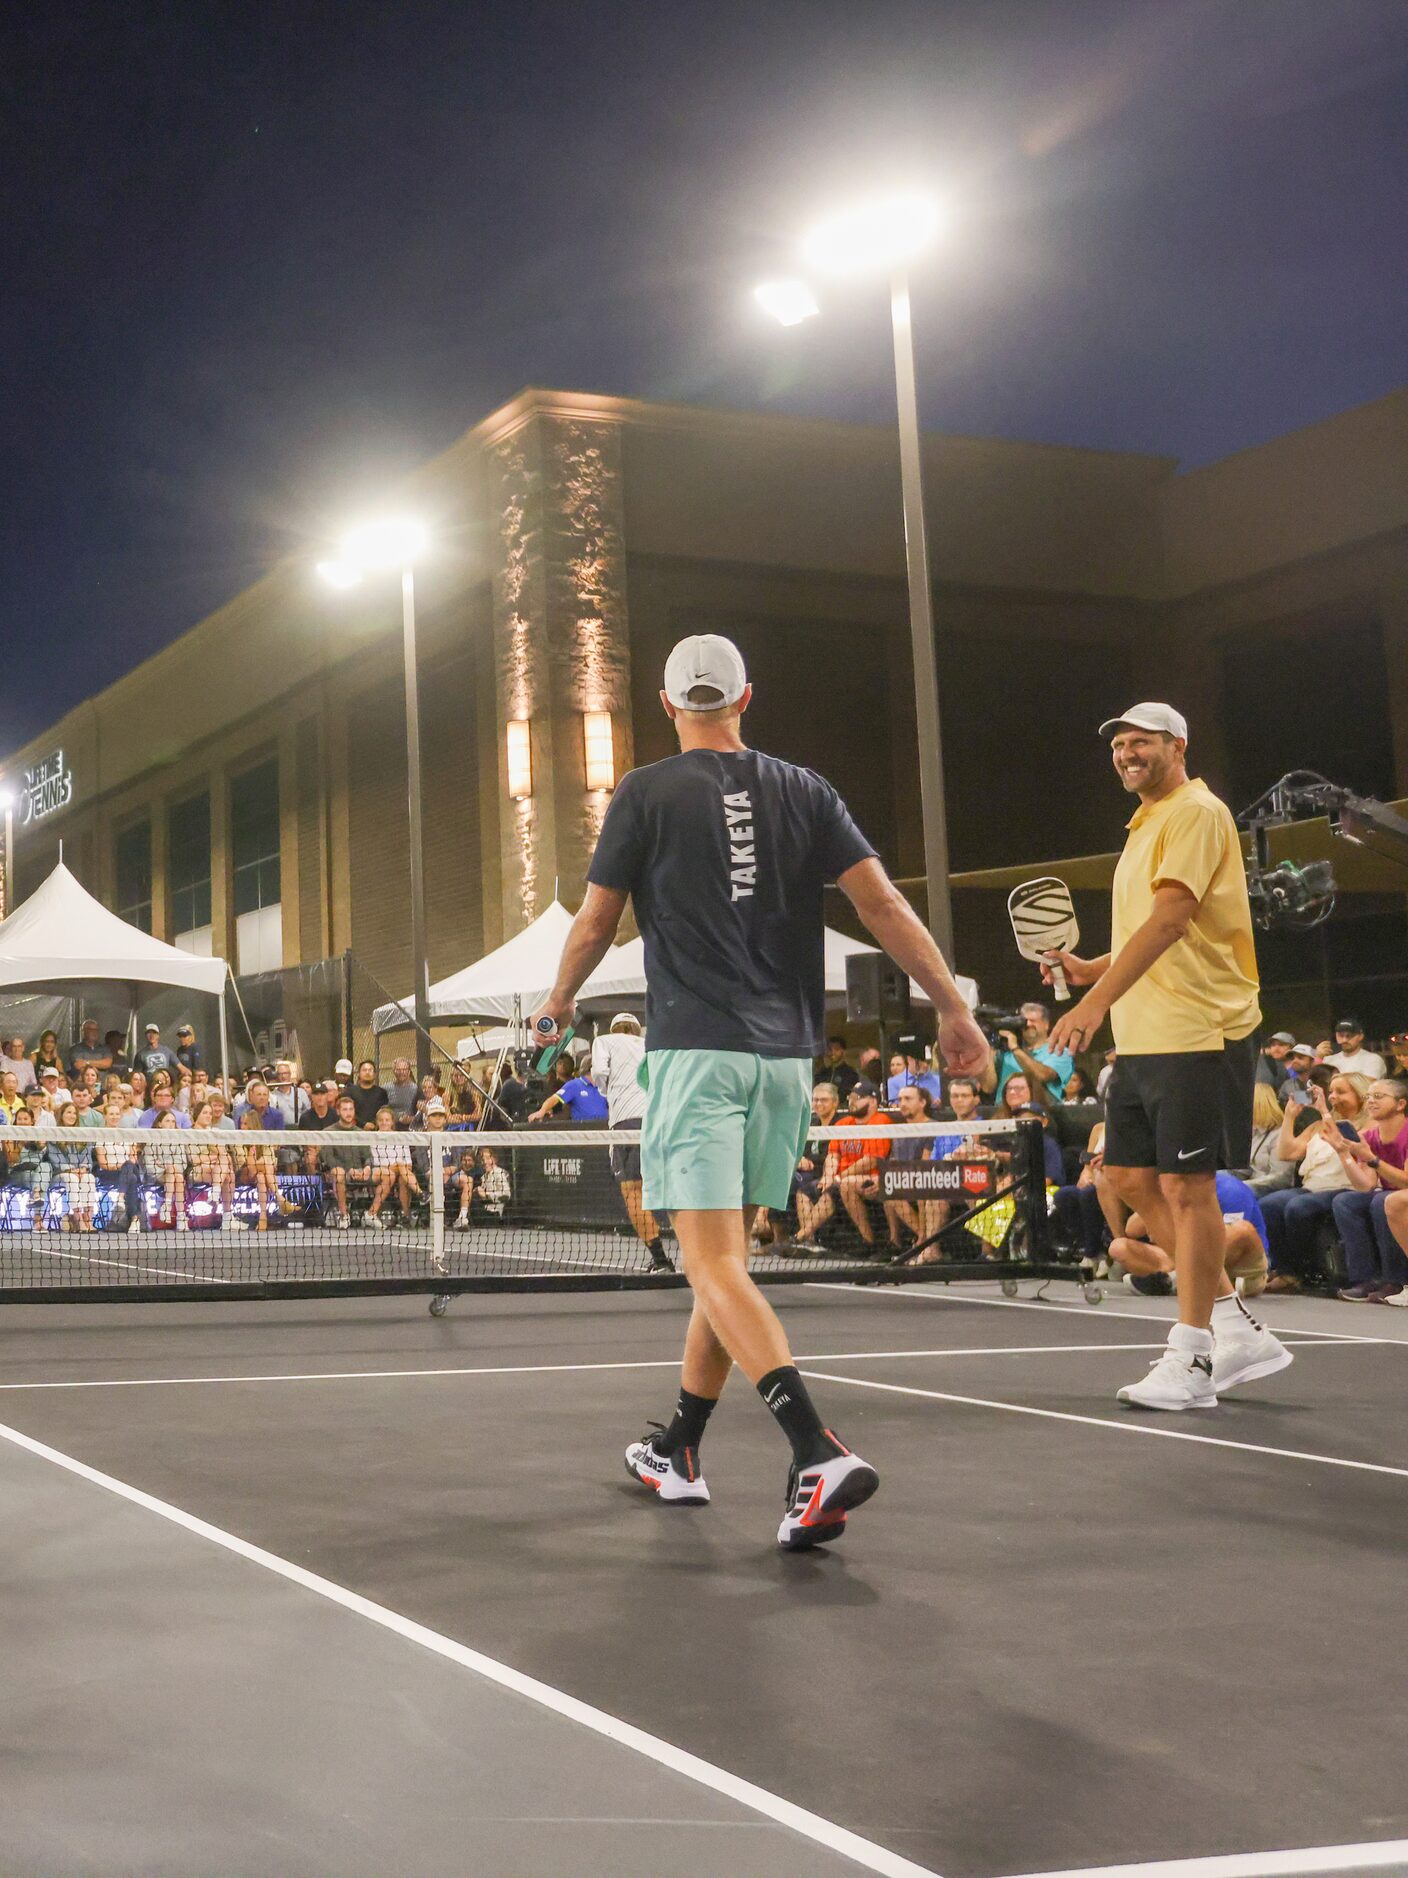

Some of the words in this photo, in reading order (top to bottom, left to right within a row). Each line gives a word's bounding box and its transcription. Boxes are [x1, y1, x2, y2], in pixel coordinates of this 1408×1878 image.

[723, 790, 757, 902] TAKEYA
[884, 1165, 960, 1195] guaranteed
[964, 1169, 987, 1184] Rate
